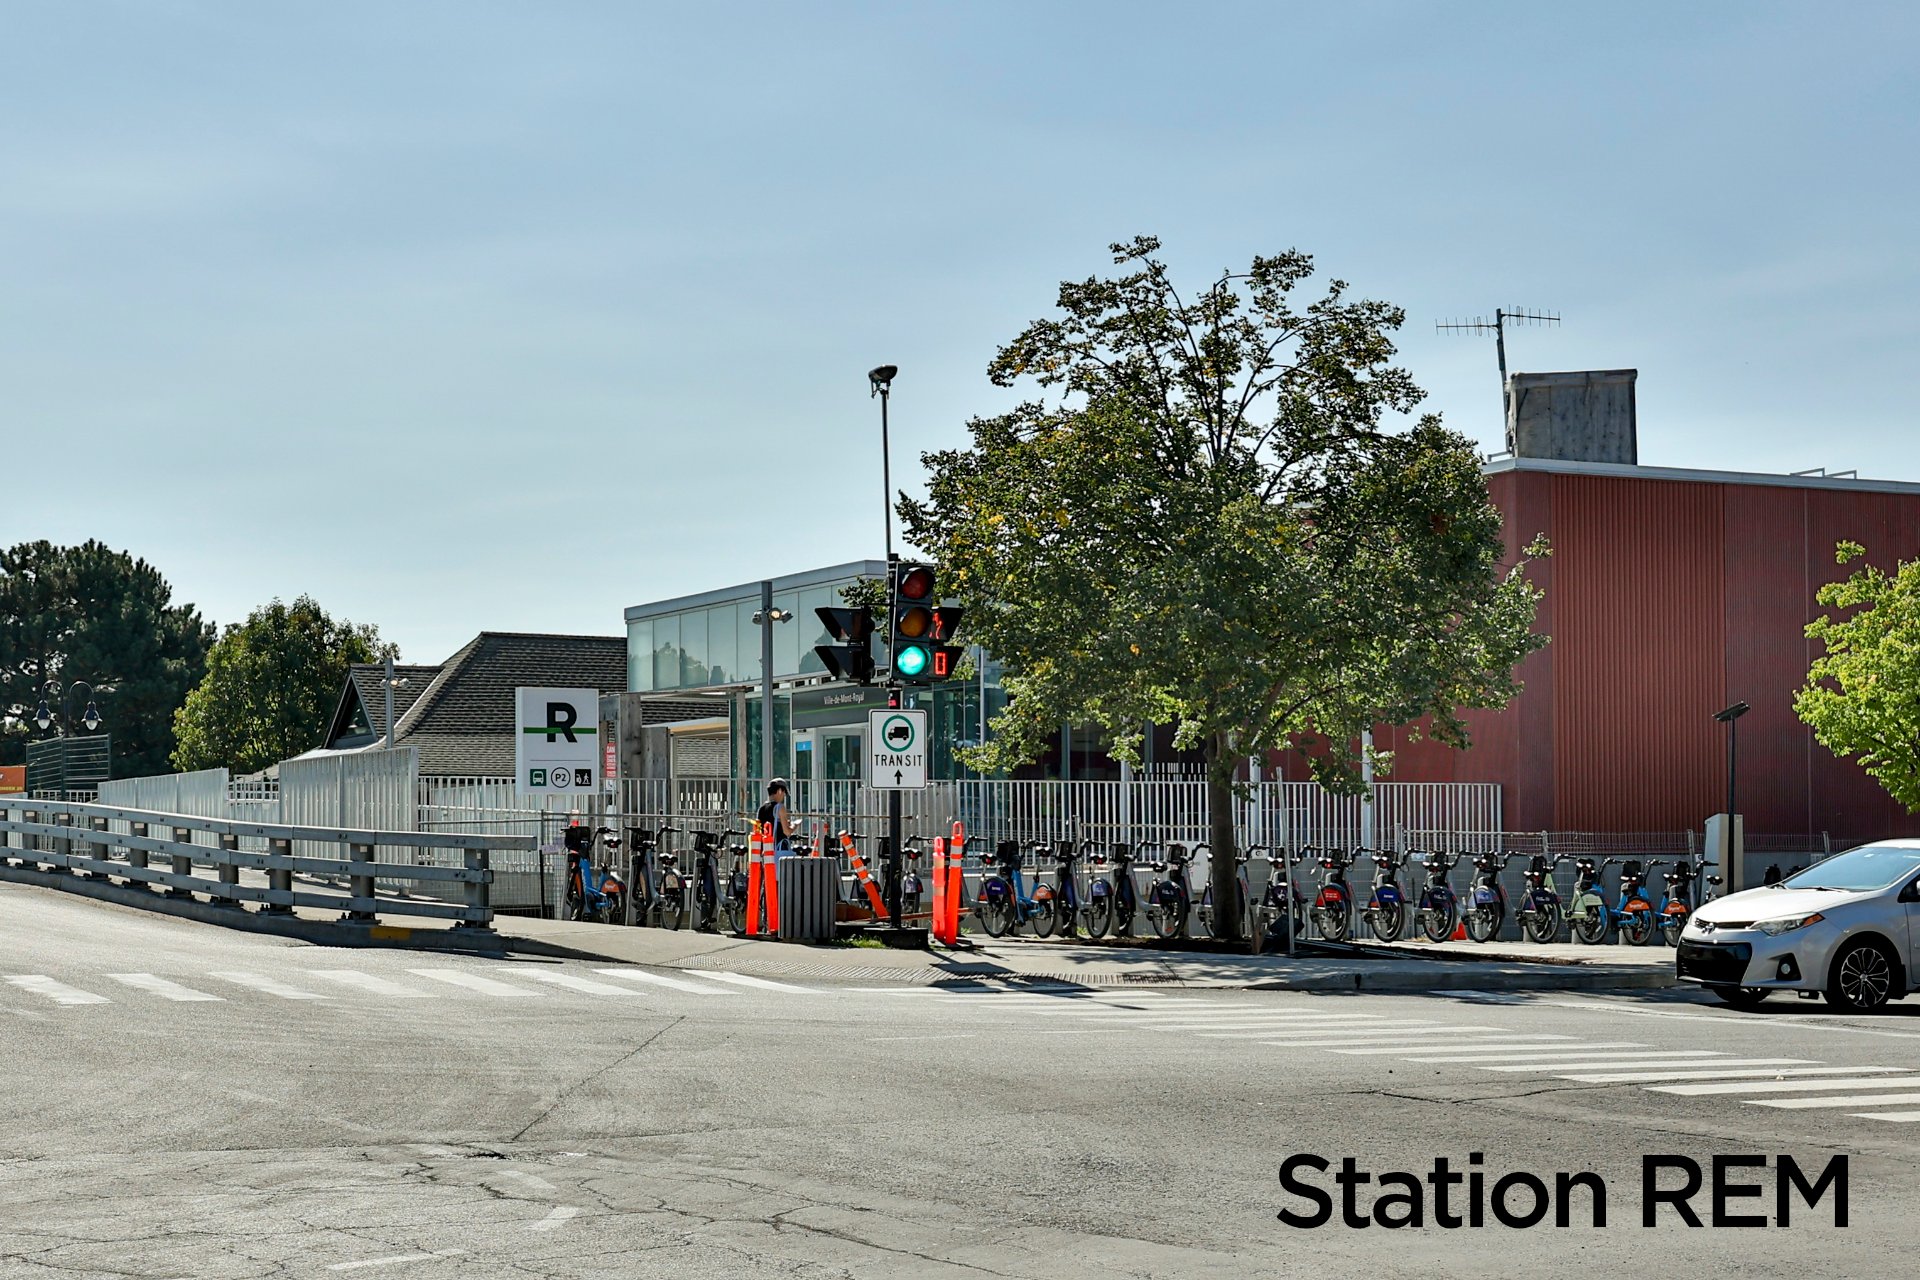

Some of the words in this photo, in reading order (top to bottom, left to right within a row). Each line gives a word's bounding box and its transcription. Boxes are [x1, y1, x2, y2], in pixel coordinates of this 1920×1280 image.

[824, 691, 865, 705] Ville-de-Mont-Royal
[547, 702, 577, 743] R
[874, 754, 923, 767] TRANSIT
[555, 774, 566, 782] P2
